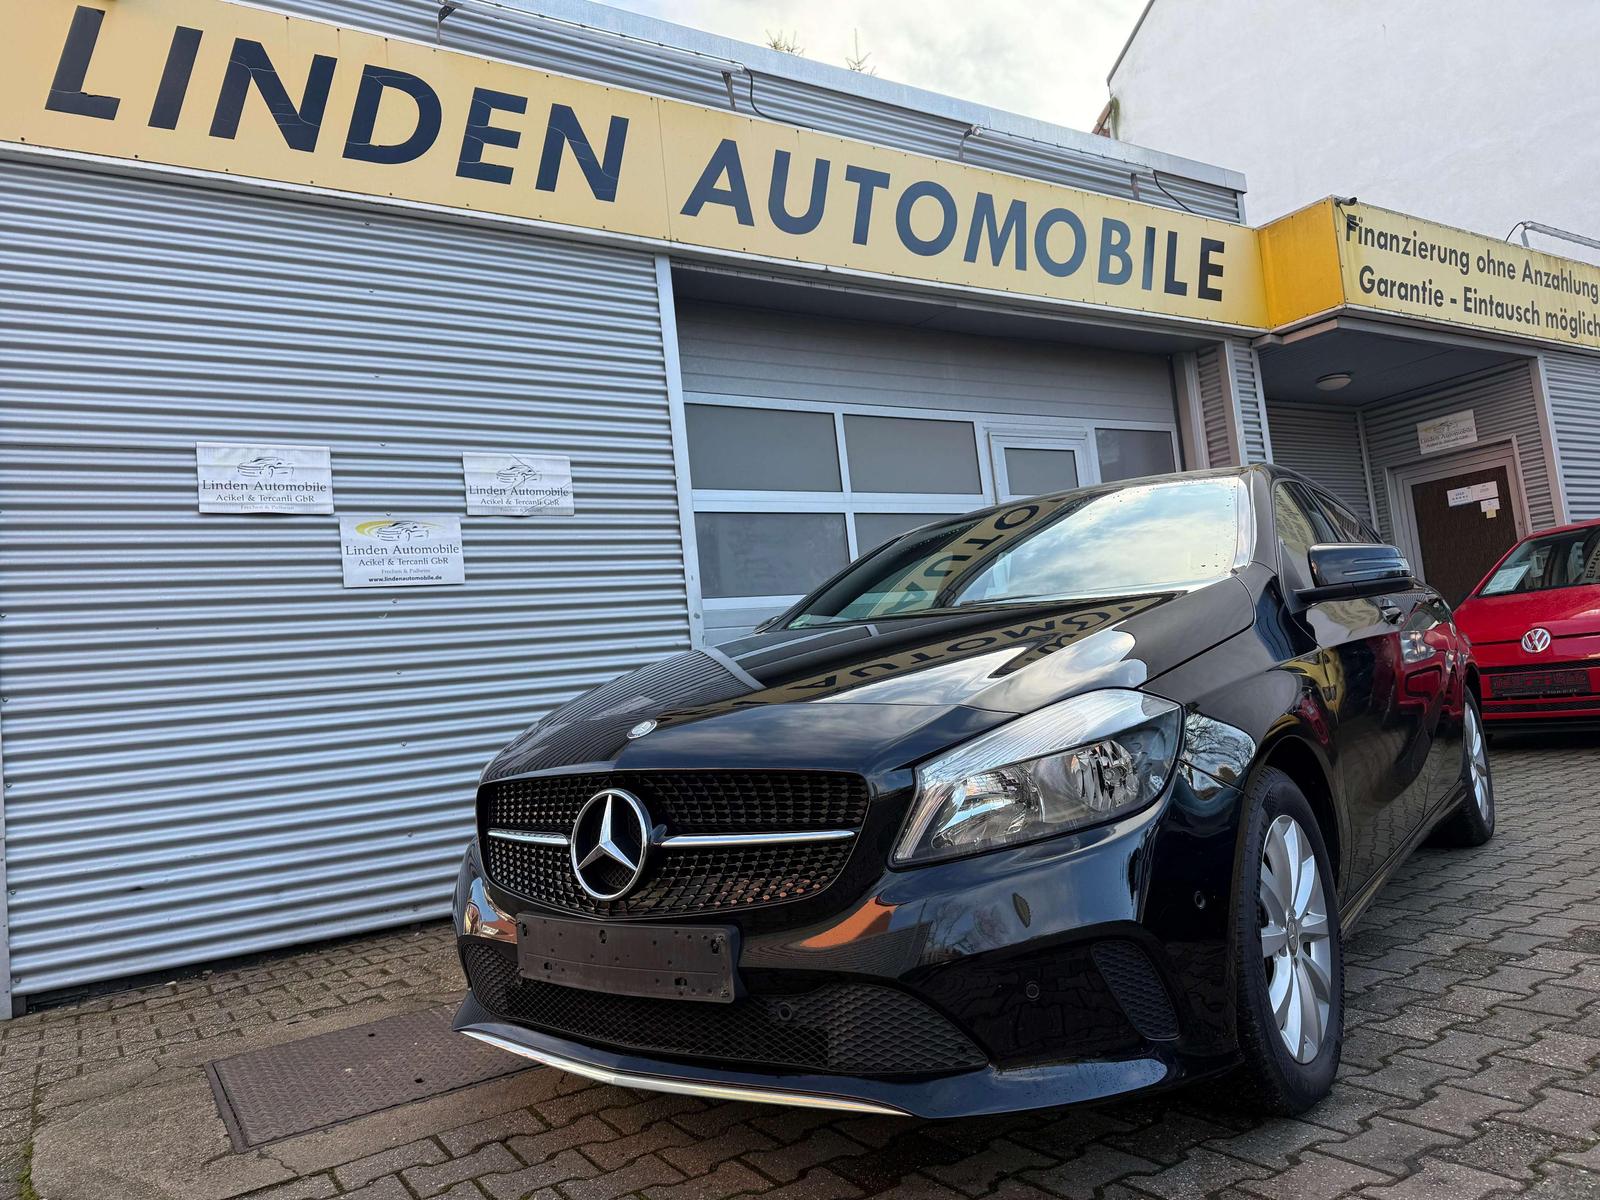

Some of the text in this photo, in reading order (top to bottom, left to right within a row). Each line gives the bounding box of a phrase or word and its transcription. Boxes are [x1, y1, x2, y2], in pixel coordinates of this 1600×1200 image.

[45, 5, 1226, 302] LINDEN AUTOMOBILE
[1346, 213, 1599, 305] Finanzierung ohne Anzahlung
[1359, 265, 1600, 339] Garantie - Eintausch möglich
[202, 479, 327, 493] Linden Automobile
[469, 485, 569, 497] Linden Automobile
[215, 494, 315, 503] Acikel & Tercanli GbR
[346, 544, 460, 556] Linden Automobile
[358, 556, 449, 567] Acikel & Tercanli GbR
[368, 575, 443, 583] www.lindenautomobile.de
